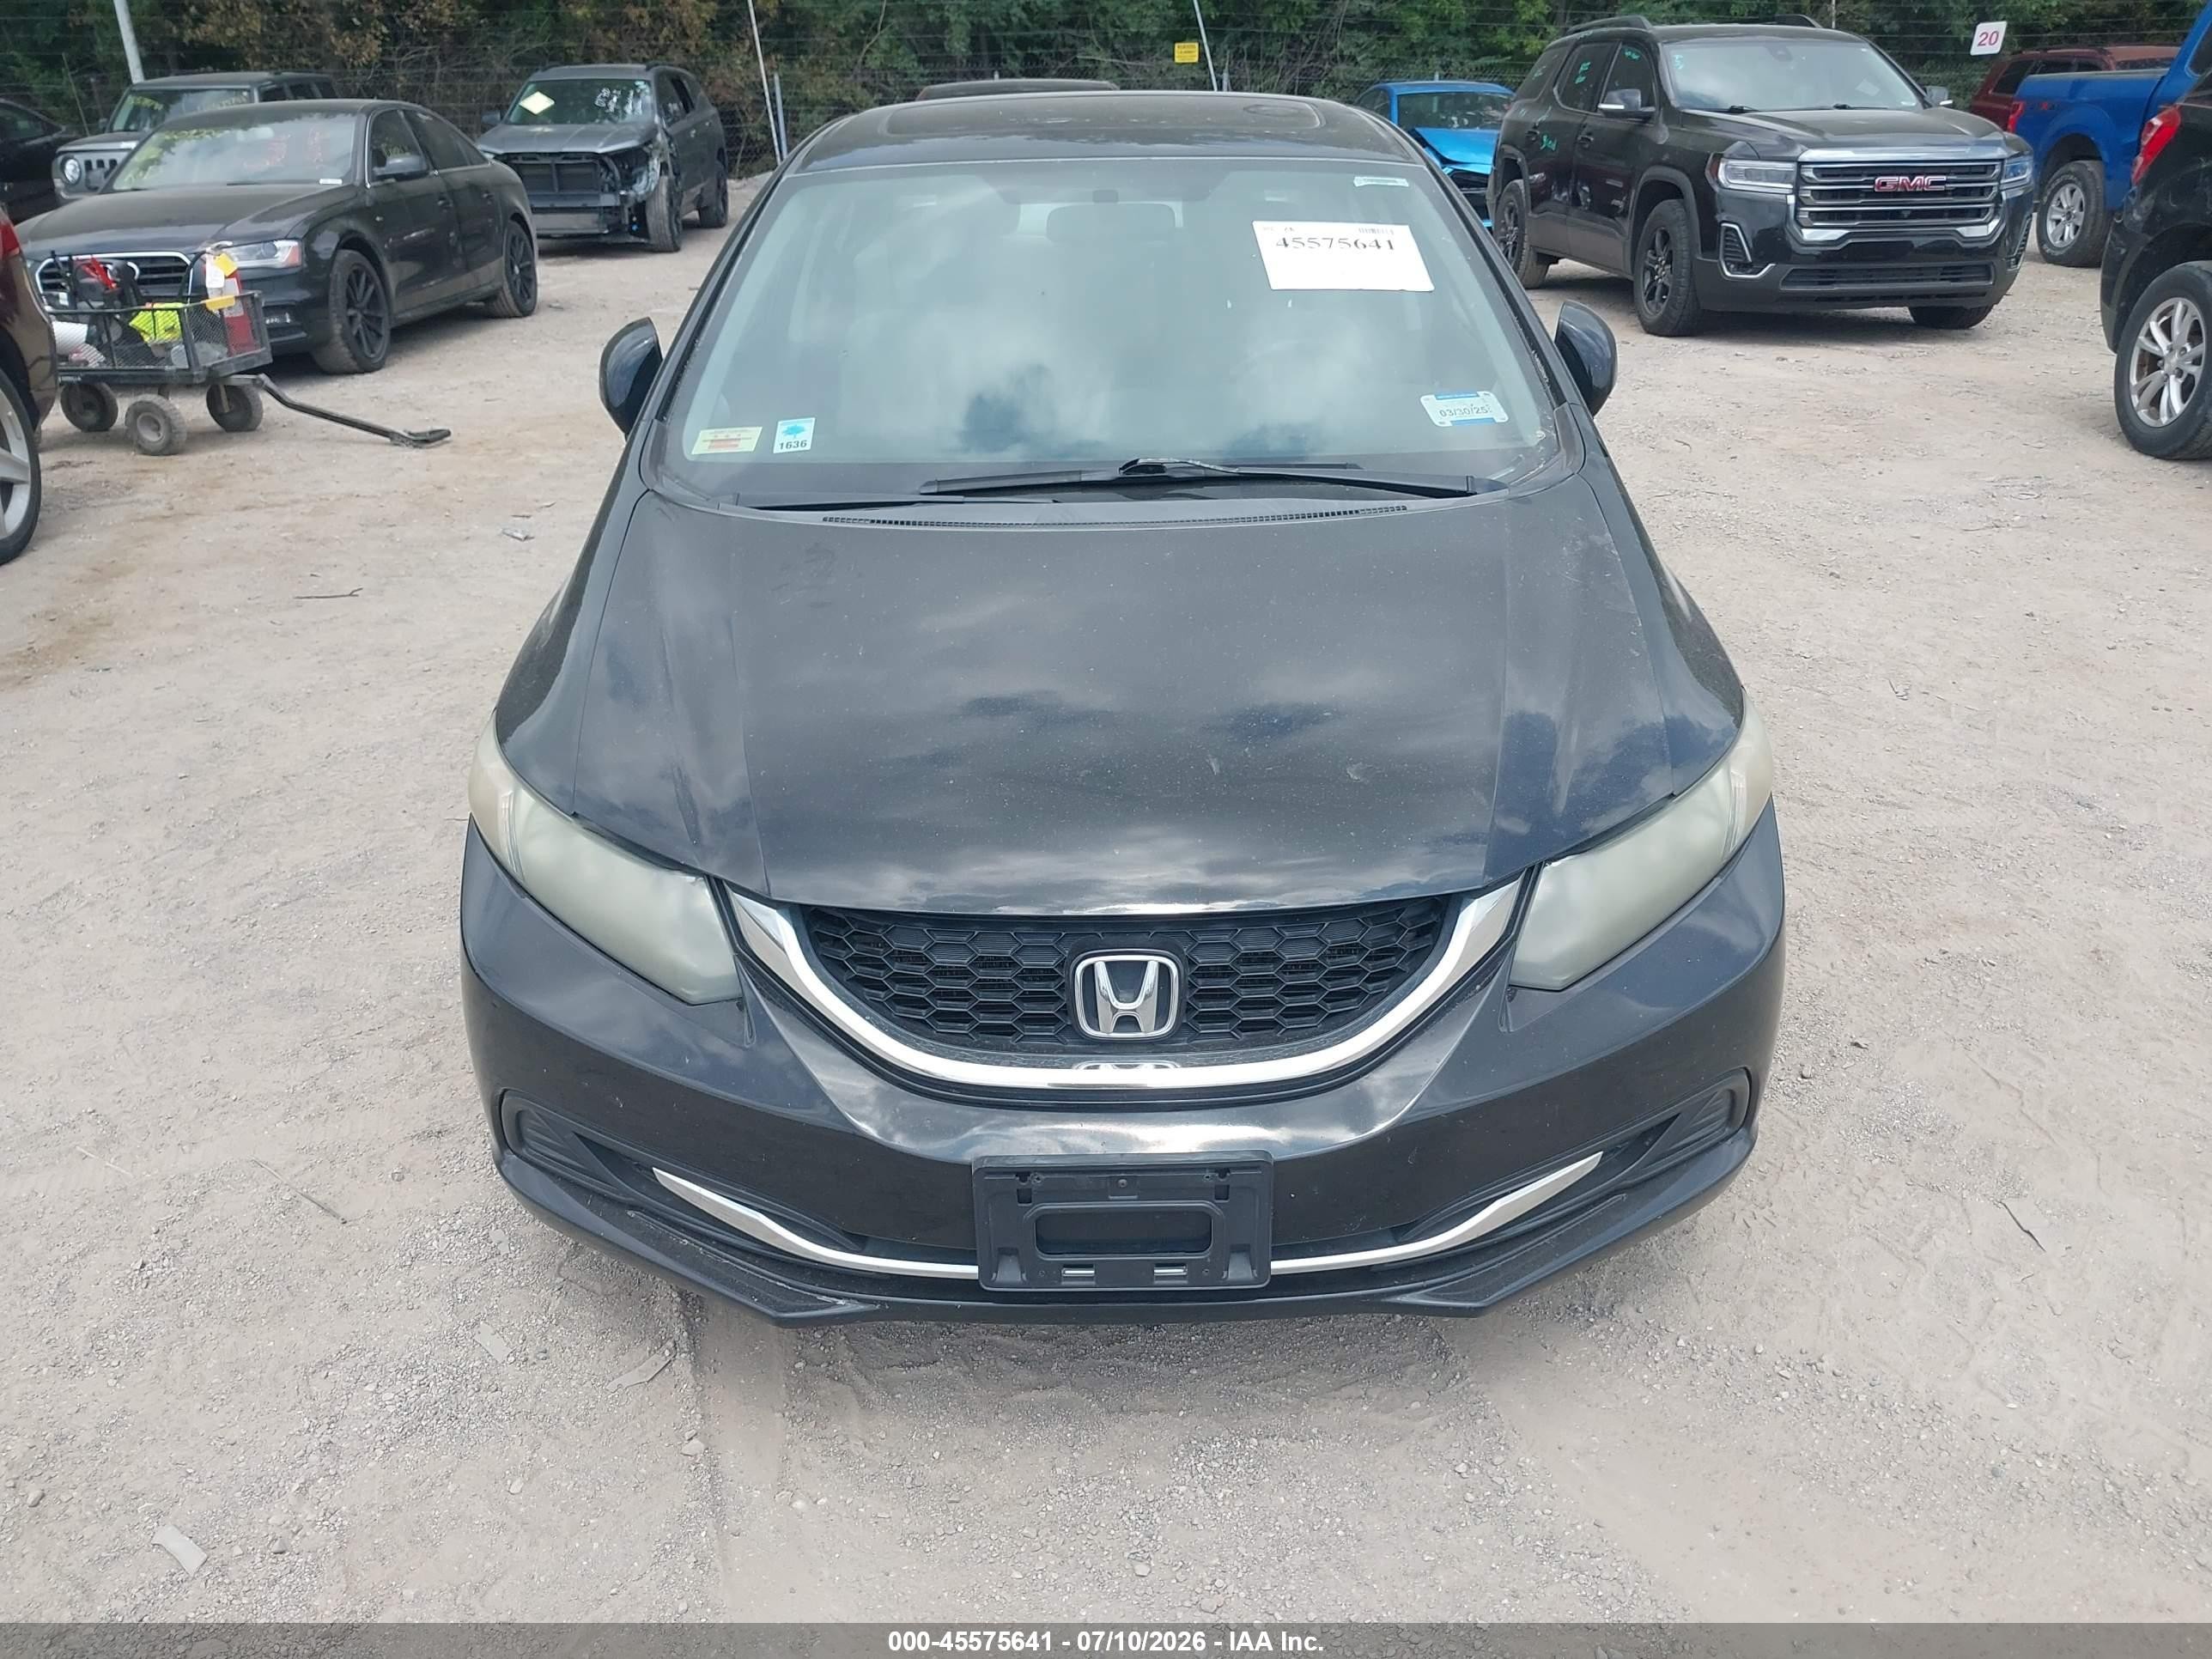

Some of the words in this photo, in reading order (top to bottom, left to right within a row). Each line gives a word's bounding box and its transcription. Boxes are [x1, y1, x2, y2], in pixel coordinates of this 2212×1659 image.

[1978, 31, 1999, 46] 20
[1875, 176, 1947, 192] GMC
[1276, 237, 1395, 250] 45575641
[779, 439, 808, 450] 1636
